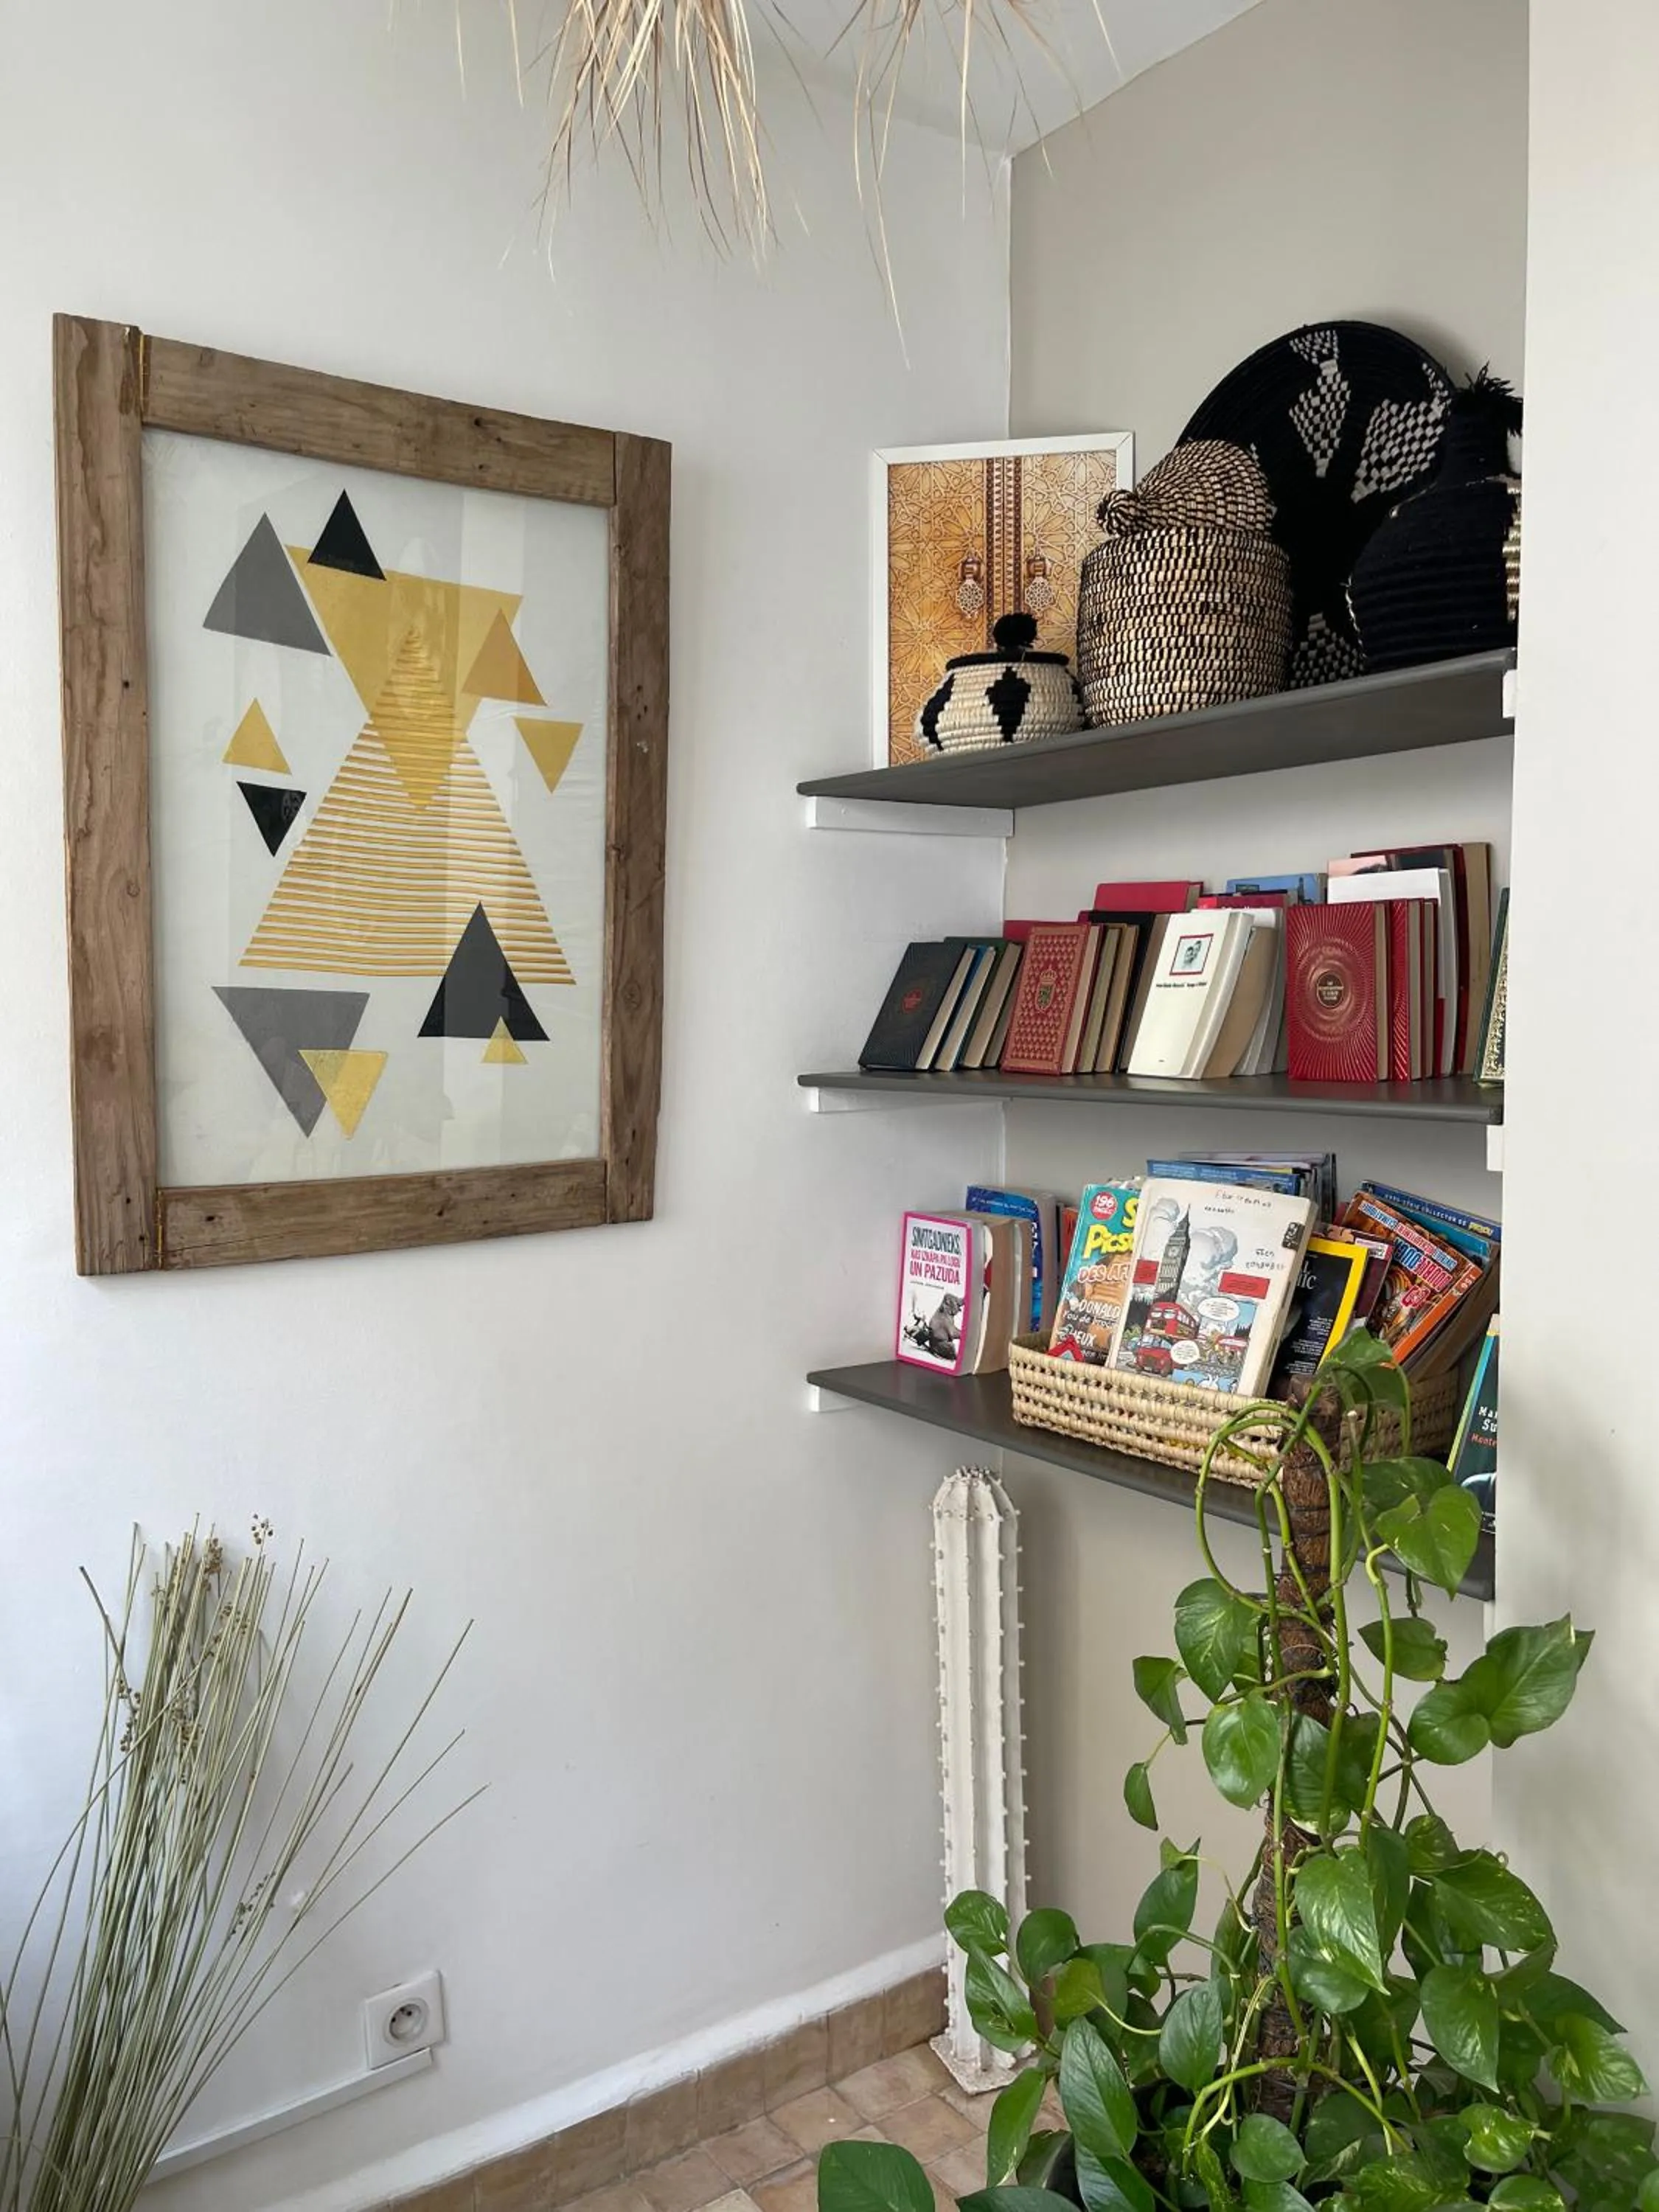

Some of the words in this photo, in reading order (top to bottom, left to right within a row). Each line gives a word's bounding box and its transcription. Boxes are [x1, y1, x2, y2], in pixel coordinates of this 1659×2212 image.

[910, 1260, 922, 1277] UN
[924, 1263, 961, 1285] PAZUDA
[1079, 1298, 1121, 1318] DONALD
